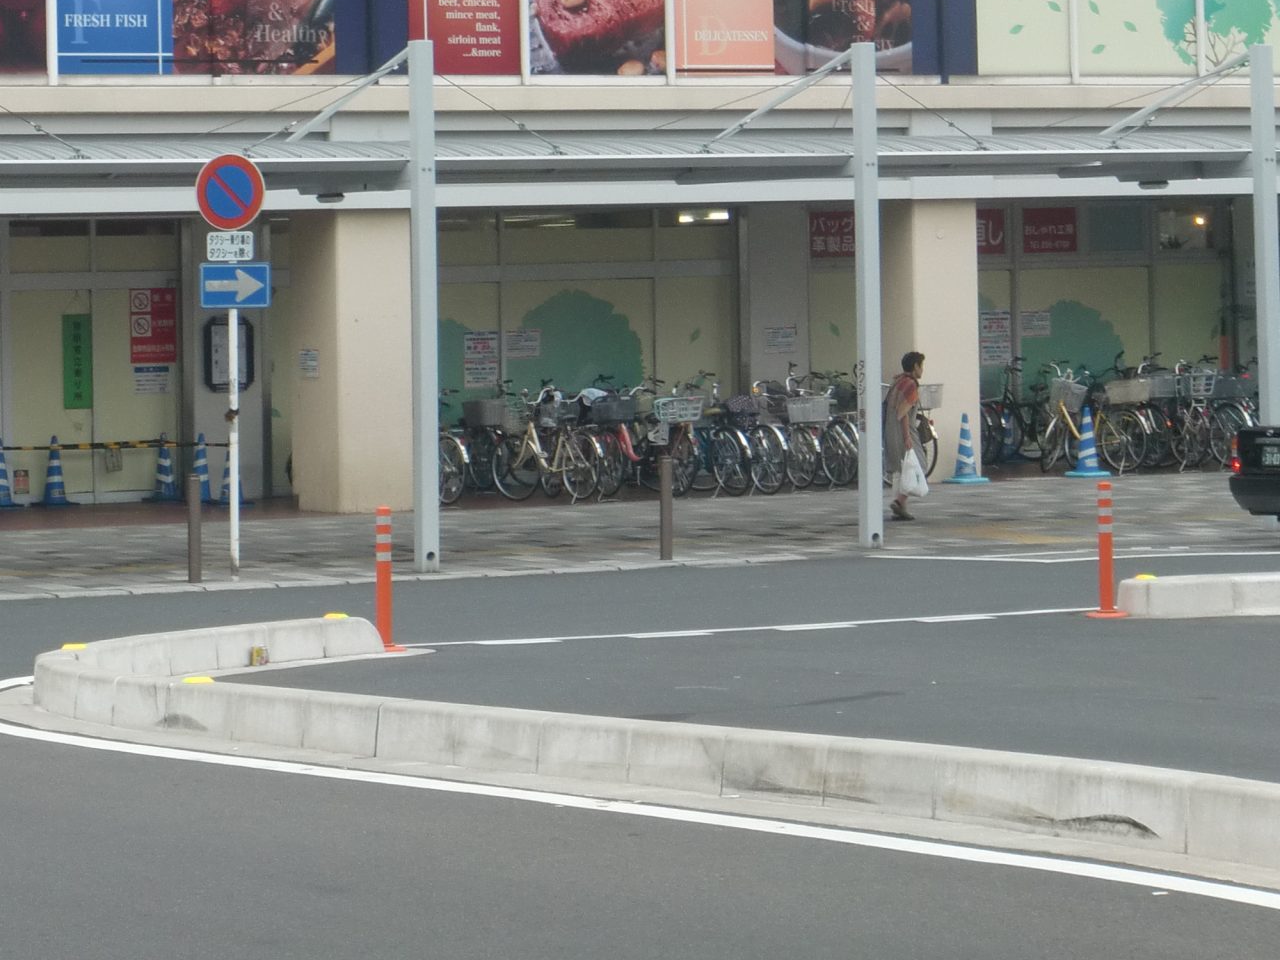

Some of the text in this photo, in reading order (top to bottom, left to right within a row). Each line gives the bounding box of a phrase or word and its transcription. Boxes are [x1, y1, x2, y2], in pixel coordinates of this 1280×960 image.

[64, 14, 148, 28] FRESH FISH
[479, 36, 501, 45] meat
